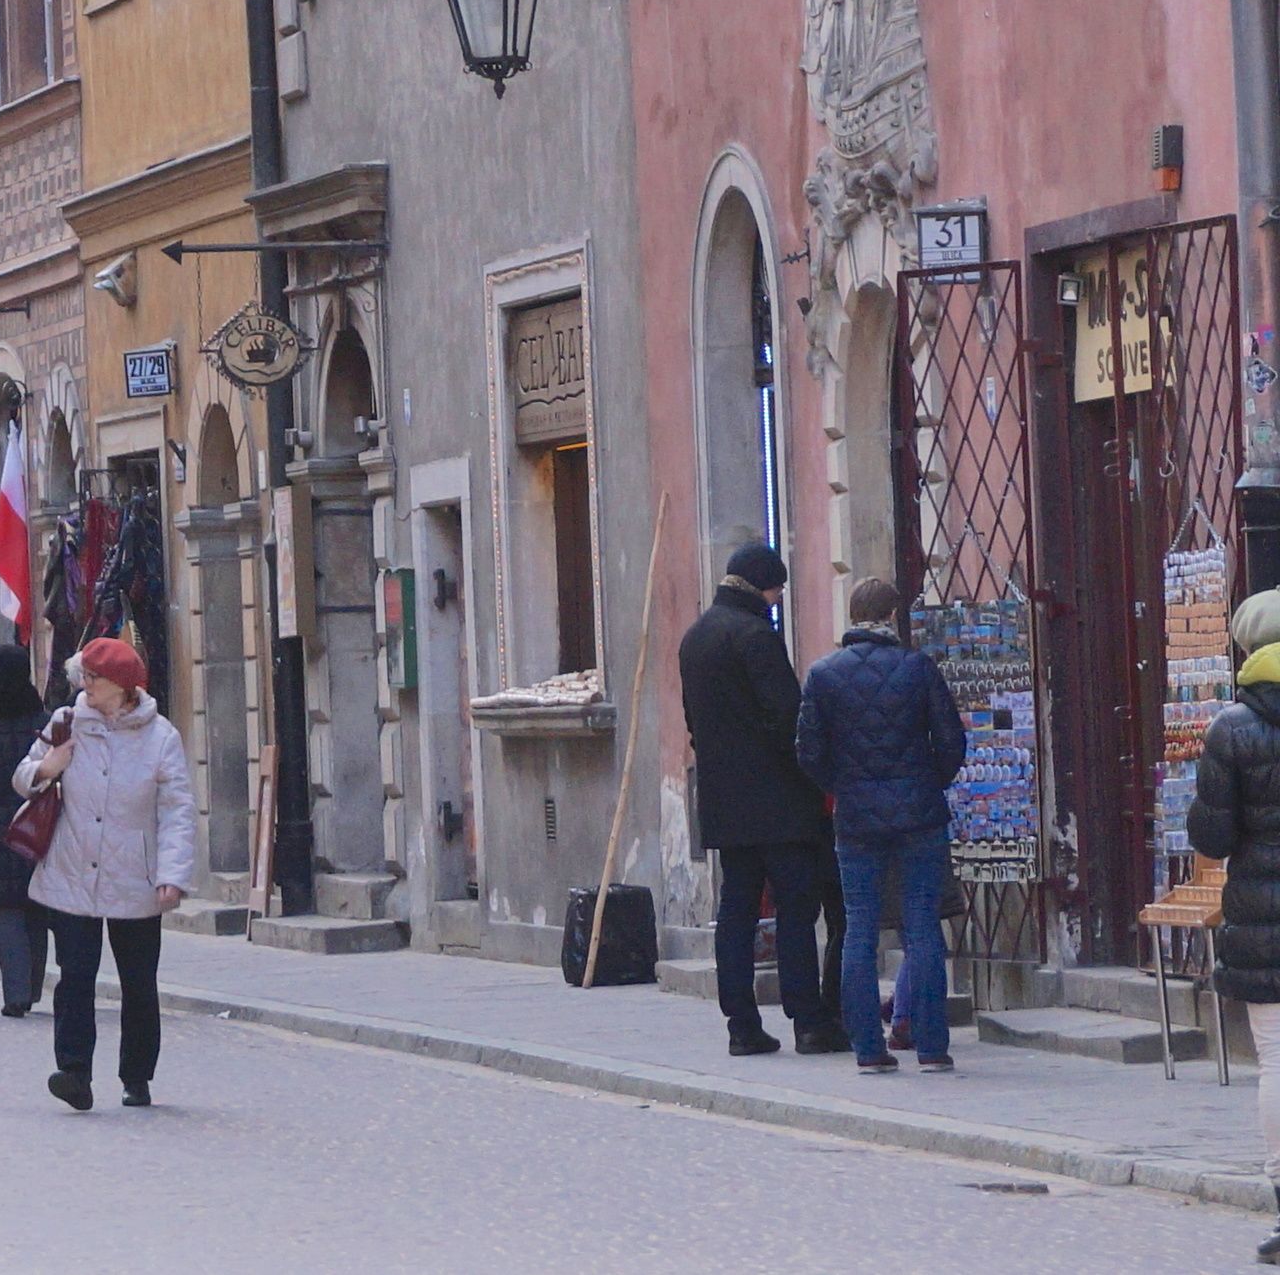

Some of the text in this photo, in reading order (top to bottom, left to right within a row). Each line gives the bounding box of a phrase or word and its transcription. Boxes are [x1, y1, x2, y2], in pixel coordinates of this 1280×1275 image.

[935, 216, 966, 247] 31
[225, 318, 296, 354] CELIBAR
[129, 356, 165, 377] 27/29
